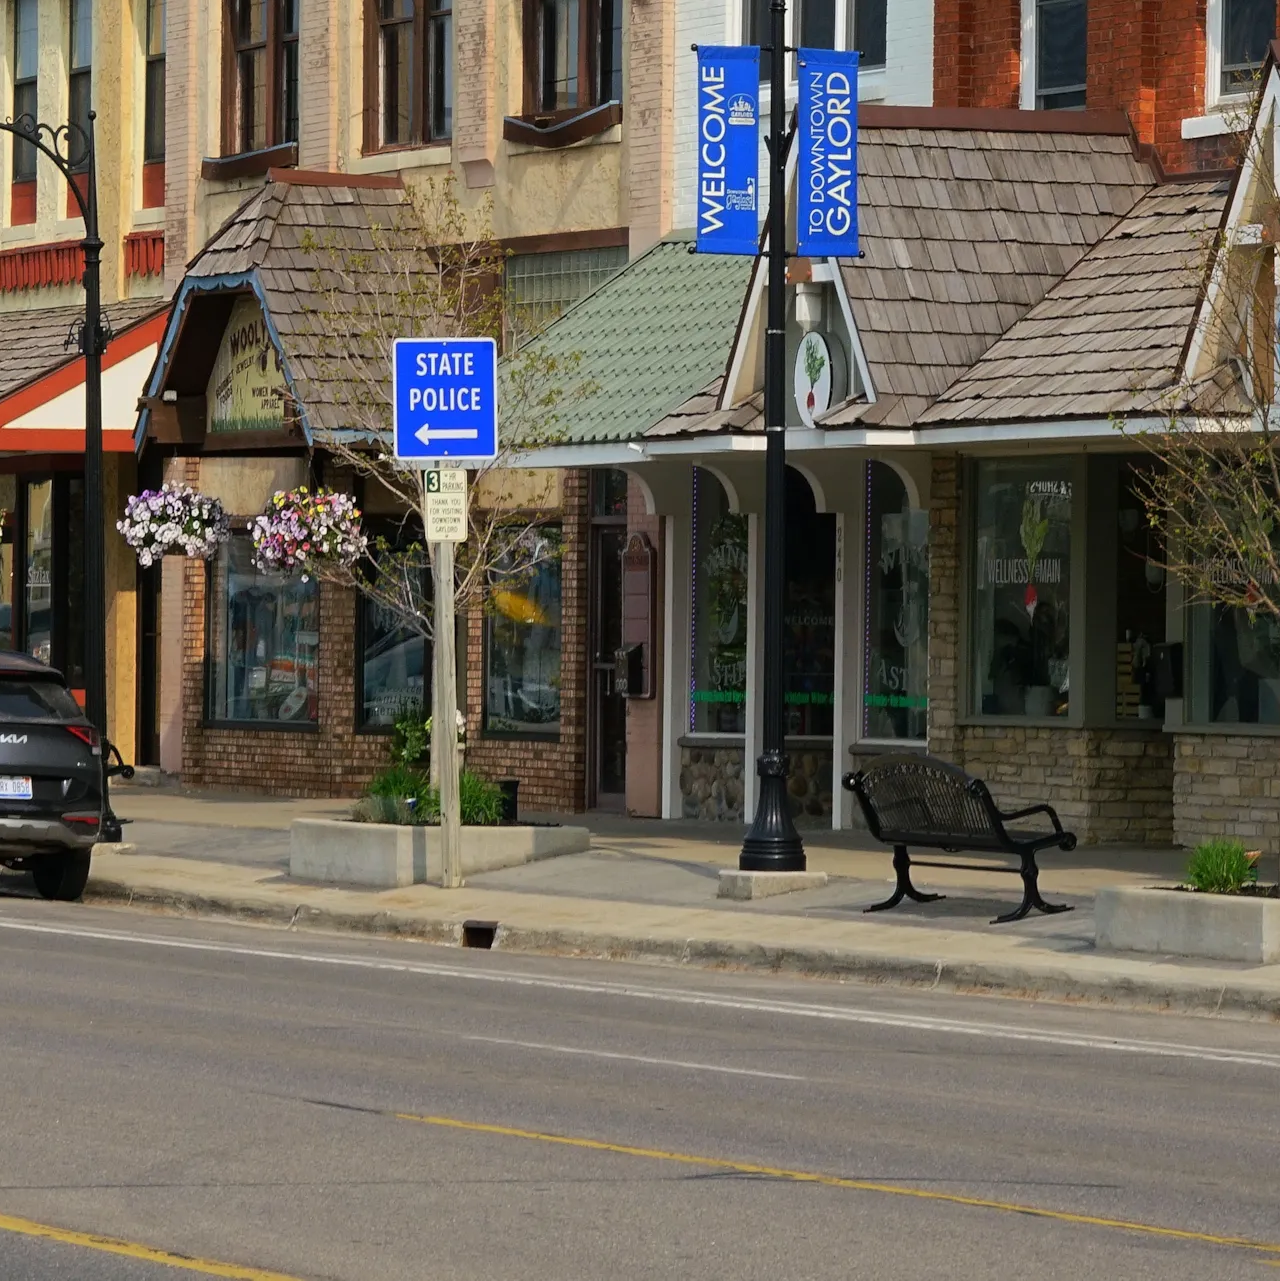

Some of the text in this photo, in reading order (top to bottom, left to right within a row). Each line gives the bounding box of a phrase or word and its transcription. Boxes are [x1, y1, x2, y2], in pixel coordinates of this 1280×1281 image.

[701, 66, 726, 235] WELCOME
[809, 71, 825, 236] TO DOWNTOWN
[826, 71, 852, 237] GAYLORD
[415, 352, 474, 377] STATE
[409, 387, 481, 411] POLICE
[428, 472, 439, 491] 3
[442, 482, 464, 491] PARKING
[430, 507, 463, 515] FOR VISITING
[432, 498, 461, 506] THANK YOU
[431, 516, 461, 524] DOWNTOWN
[435, 525, 458, 533] GAYLORD
[987, 558, 1029, 584] WELLNESS
[1039, 558, 1061, 584] MAIN
